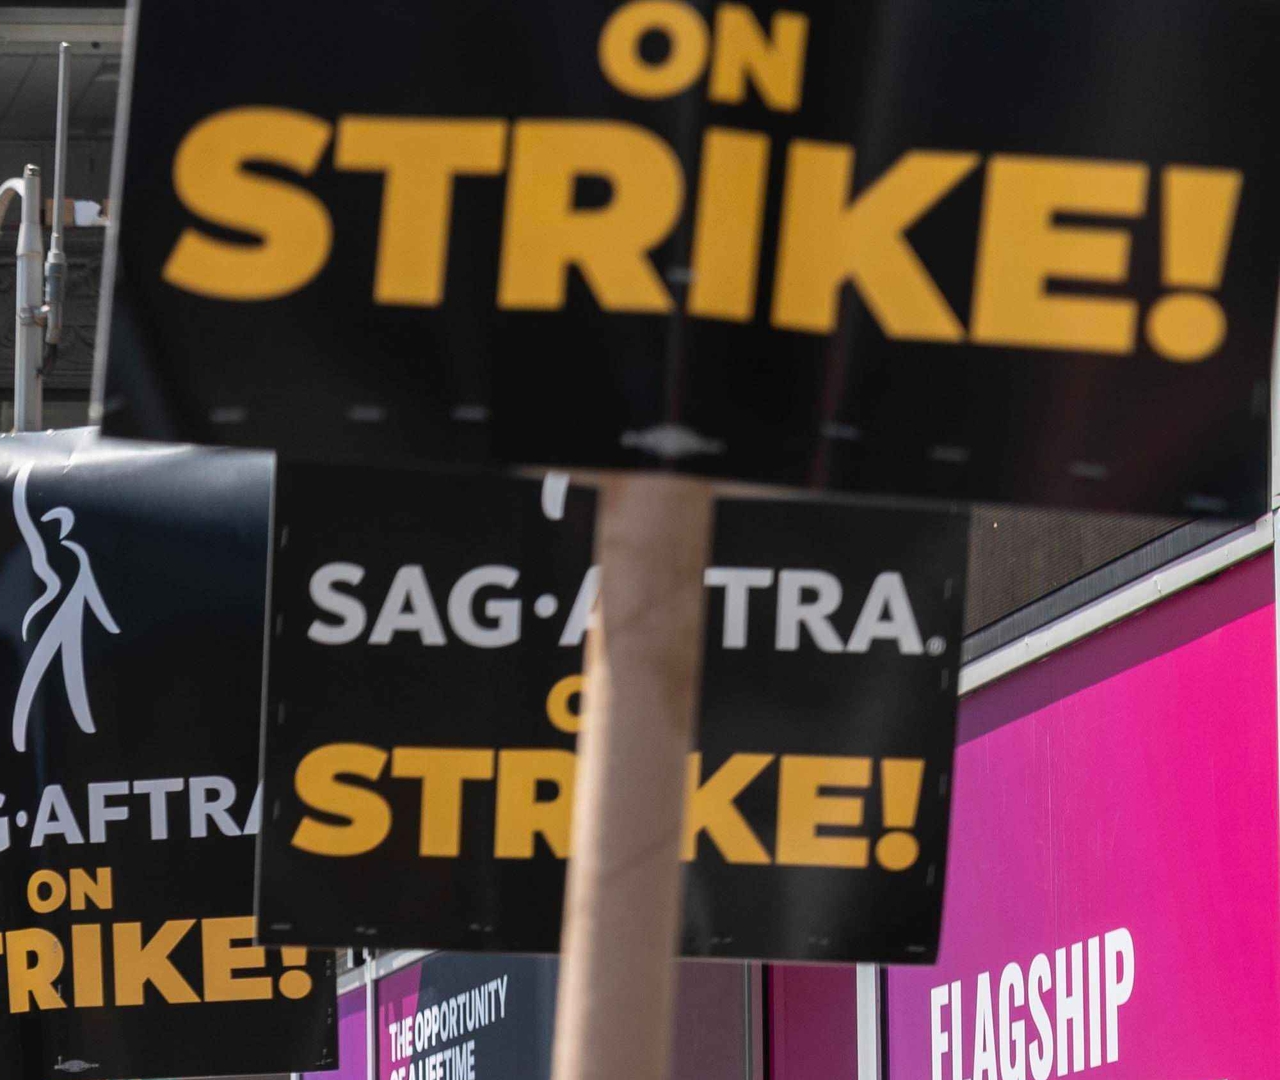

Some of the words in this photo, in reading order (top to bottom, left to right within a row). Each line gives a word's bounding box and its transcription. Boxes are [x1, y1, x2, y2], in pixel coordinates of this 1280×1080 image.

[598, 0, 810, 113] ON
[160, 105, 1244, 363] STRIKE!
[291, 742, 925, 873] STRKE!
[27, 866, 113, 914] ON
[389, 1016, 413, 1063] THE
[414, 974, 507, 1053] OPPORTUNITY
